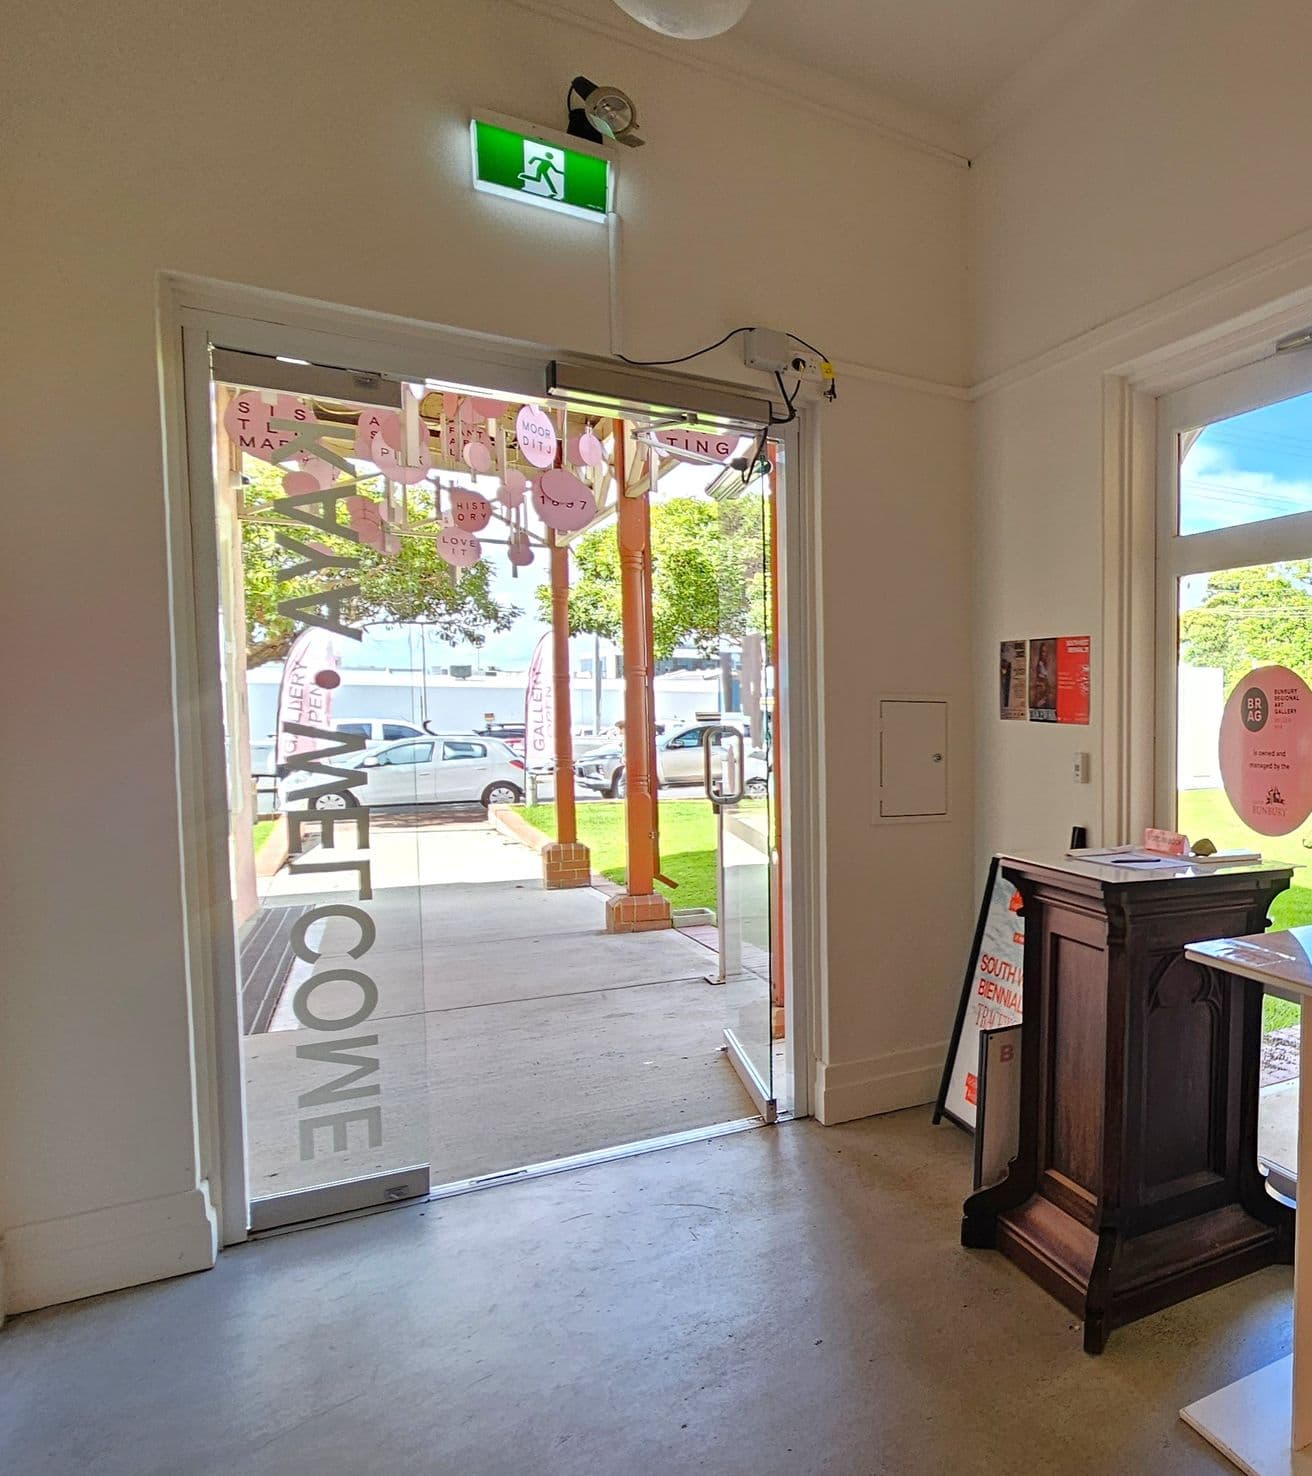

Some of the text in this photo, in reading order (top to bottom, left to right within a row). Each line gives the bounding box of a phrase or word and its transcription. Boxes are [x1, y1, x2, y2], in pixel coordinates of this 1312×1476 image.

[457, 502, 486, 510] HIST
[457, 513, 487, 521] ORY
[442, 536, 476, 548] LOVE
[452, 548, 467, 556] IT
[1247, 698, 1262, 709] BR
[1247, 710, 1263, 722] AG
[980, 954, 1017, 981] SOUTH
